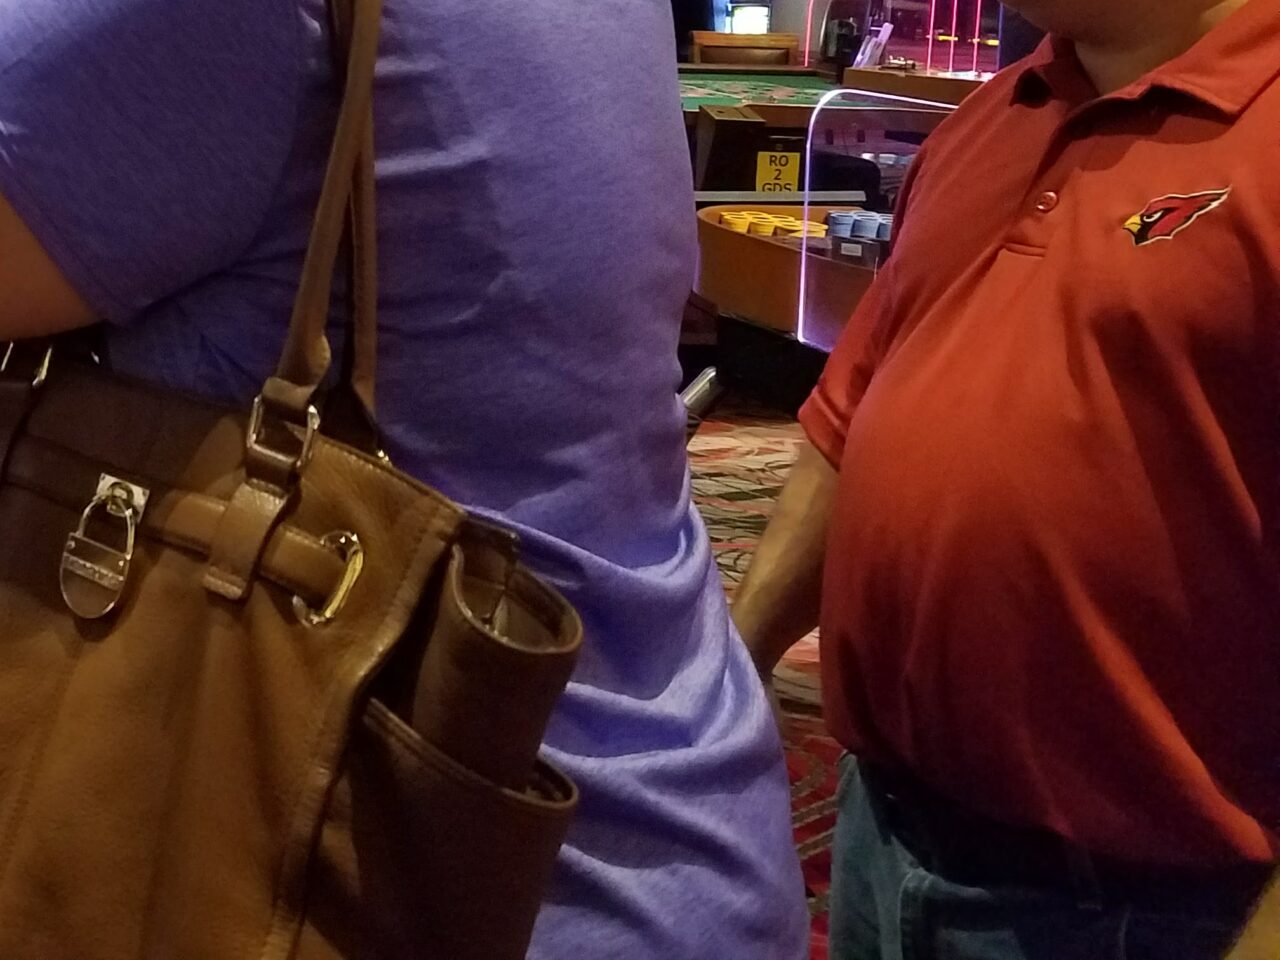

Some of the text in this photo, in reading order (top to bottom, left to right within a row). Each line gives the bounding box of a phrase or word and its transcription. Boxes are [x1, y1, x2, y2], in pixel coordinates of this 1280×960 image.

[769, 155, 789, 167] RO
[773, 169, 782, 181] 2
[762, 182, 793, 192] GDS
